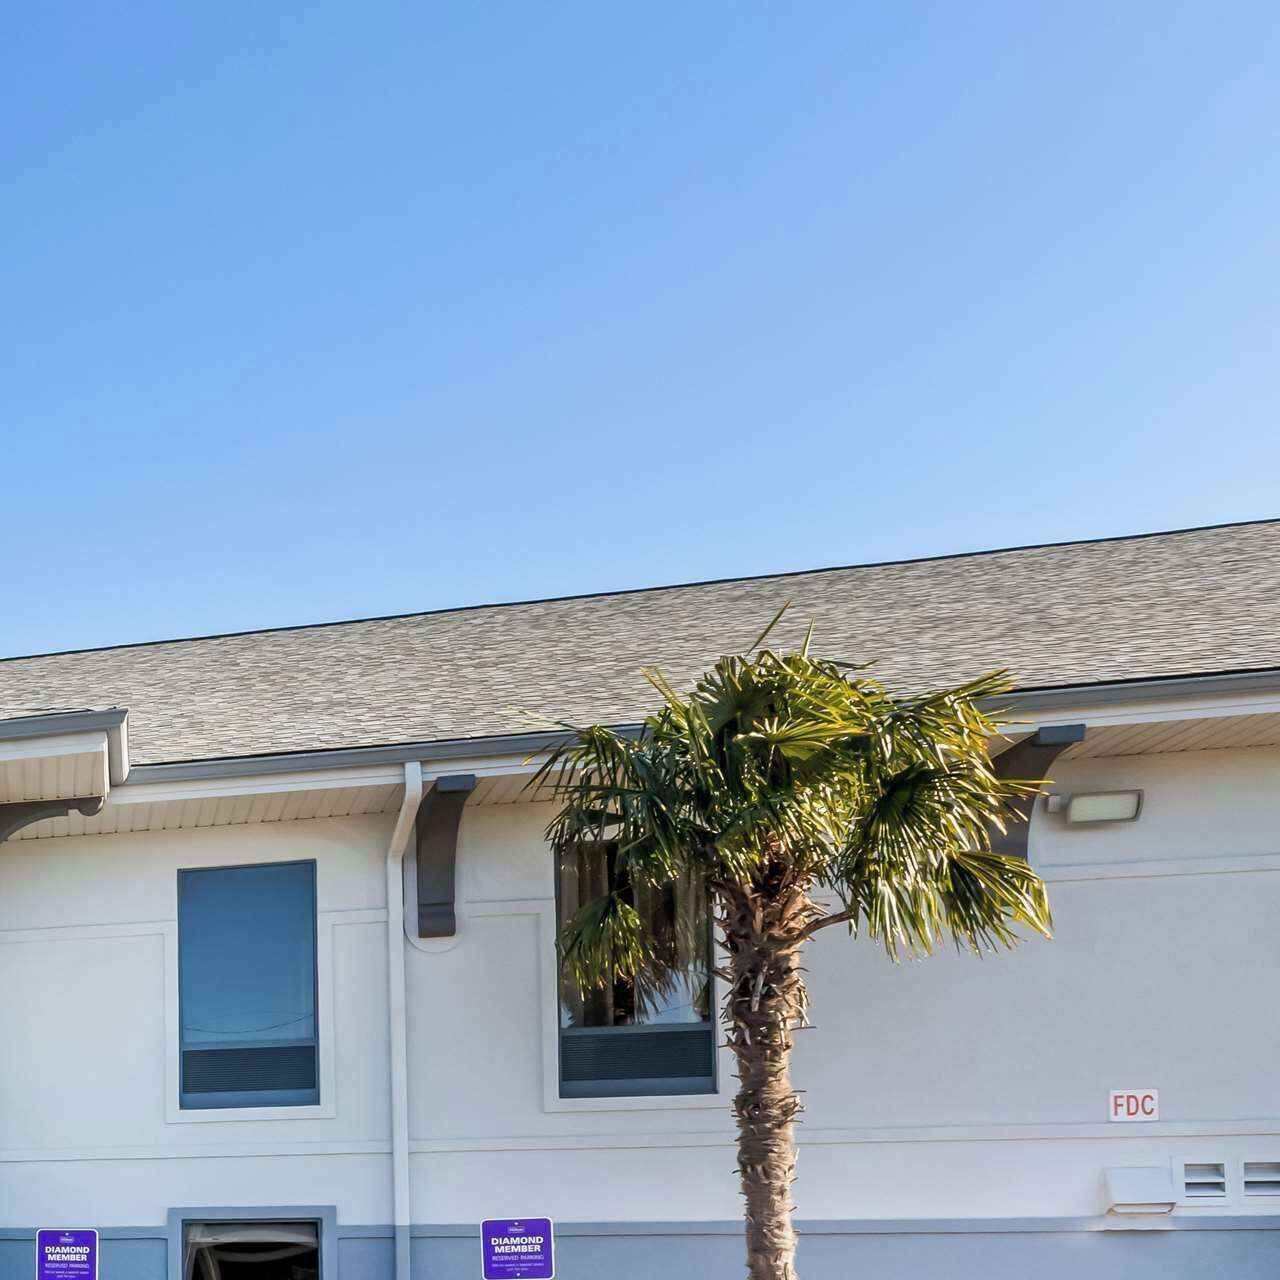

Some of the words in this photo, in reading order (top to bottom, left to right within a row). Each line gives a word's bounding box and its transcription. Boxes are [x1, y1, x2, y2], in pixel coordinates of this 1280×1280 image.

[1113, 1094, 1154, 1116] FDC
[491, 1236, 544, 1245] DIAMOND
[45, 1246, 90, 1254] DIAMOND
[494, 1244, 541, 1253] MEMBER
